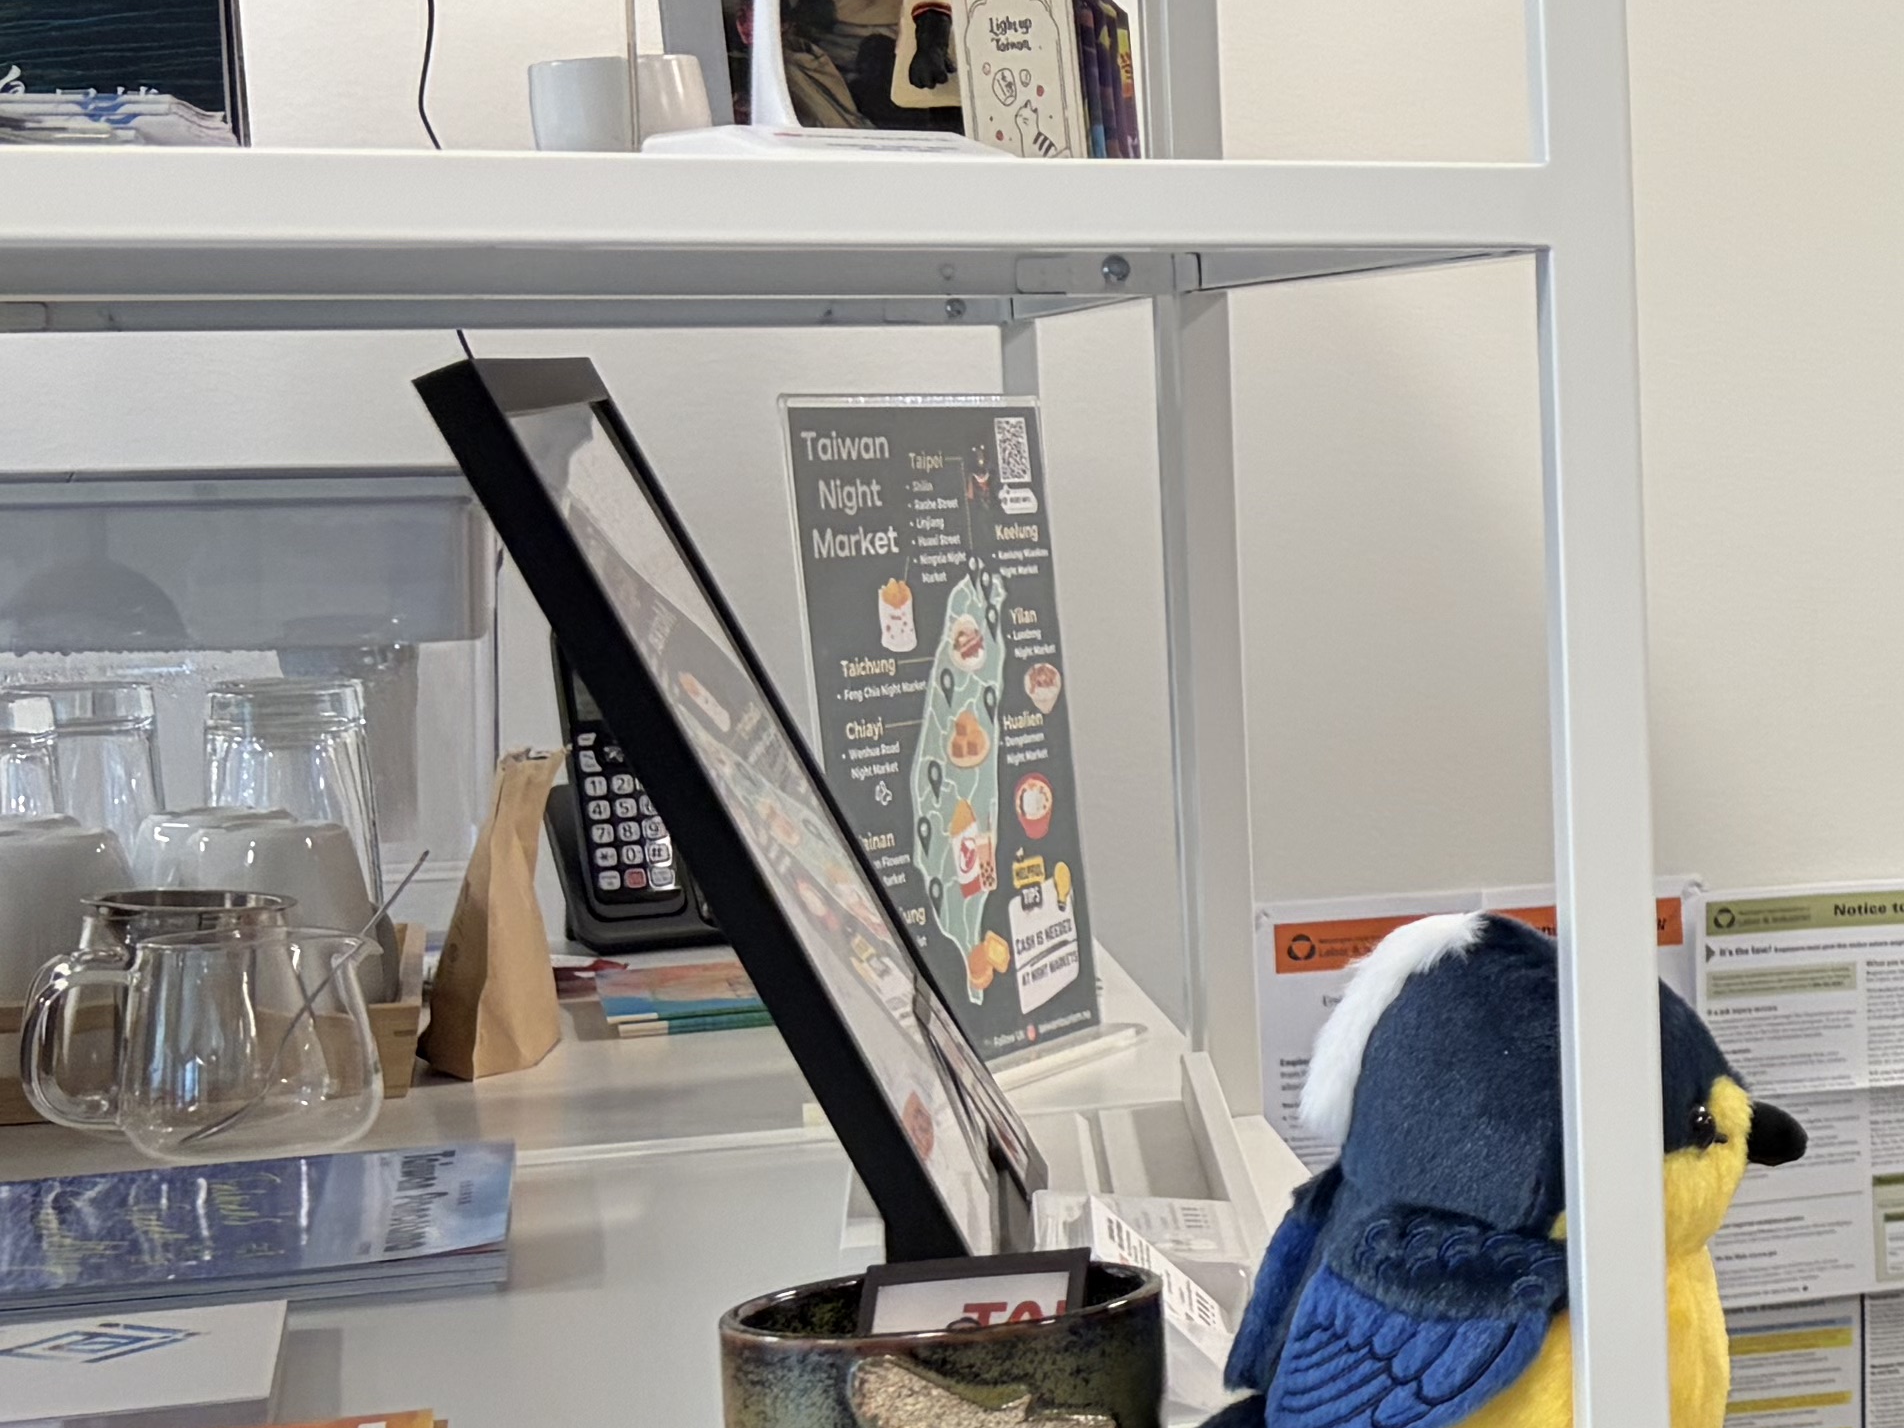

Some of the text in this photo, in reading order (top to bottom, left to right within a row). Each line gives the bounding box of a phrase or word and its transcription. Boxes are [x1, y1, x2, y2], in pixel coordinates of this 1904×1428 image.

[800, 432, 889, 460] Taiwan
[908, 452, 944, 472] Taipei
[818, 479, 882, 515] Night
[812, 526, 899, 559] Market
[995, 524, 1038, 543] Keelung
[840, 657, 896, 679] Taichung
[881, 684, 900, 697] Night
[846, 717, 884, 740] Chiayi
[1003, 711, 1043, 730] Hualien
[851, 762, 899, 780] Night Market
[1023, 887, 1040, 904] TIPS
[1834, 901, 1887, 917] Notice
[1015, 935, 1035, 955] CASH
[1048, 918, 1073, 939] NEEDED
